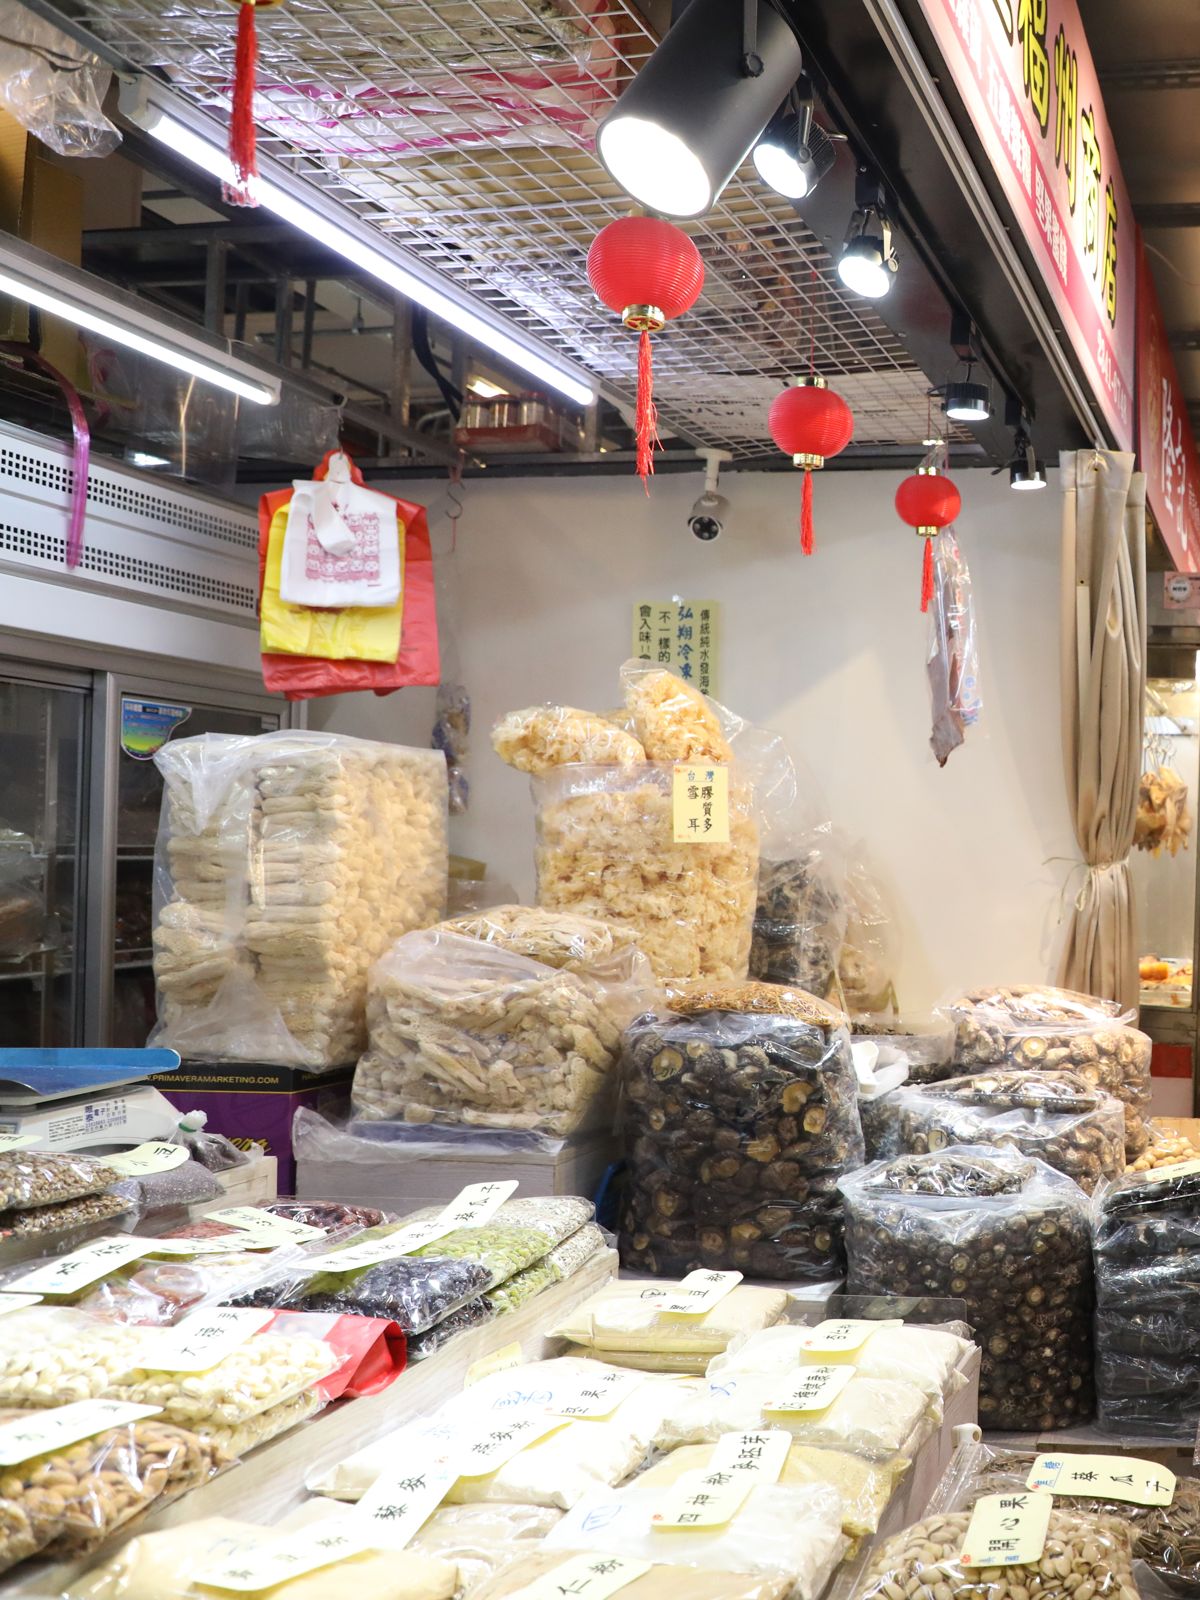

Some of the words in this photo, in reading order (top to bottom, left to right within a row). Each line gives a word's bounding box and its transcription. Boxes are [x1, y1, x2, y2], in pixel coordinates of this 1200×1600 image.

[1000, 0, 1119, 329] 福州商店
[658, 611, 671, 663] 不一樣的
[687, 770, 715, 782] 台灣
[687, 785, 700, 833] 雪耳
[701, 785, 715, 834] 膠質多
[1071, 1470, 1170, 1493] 葵瓜子
[987, 1494, 1030, 1553] 開心果
